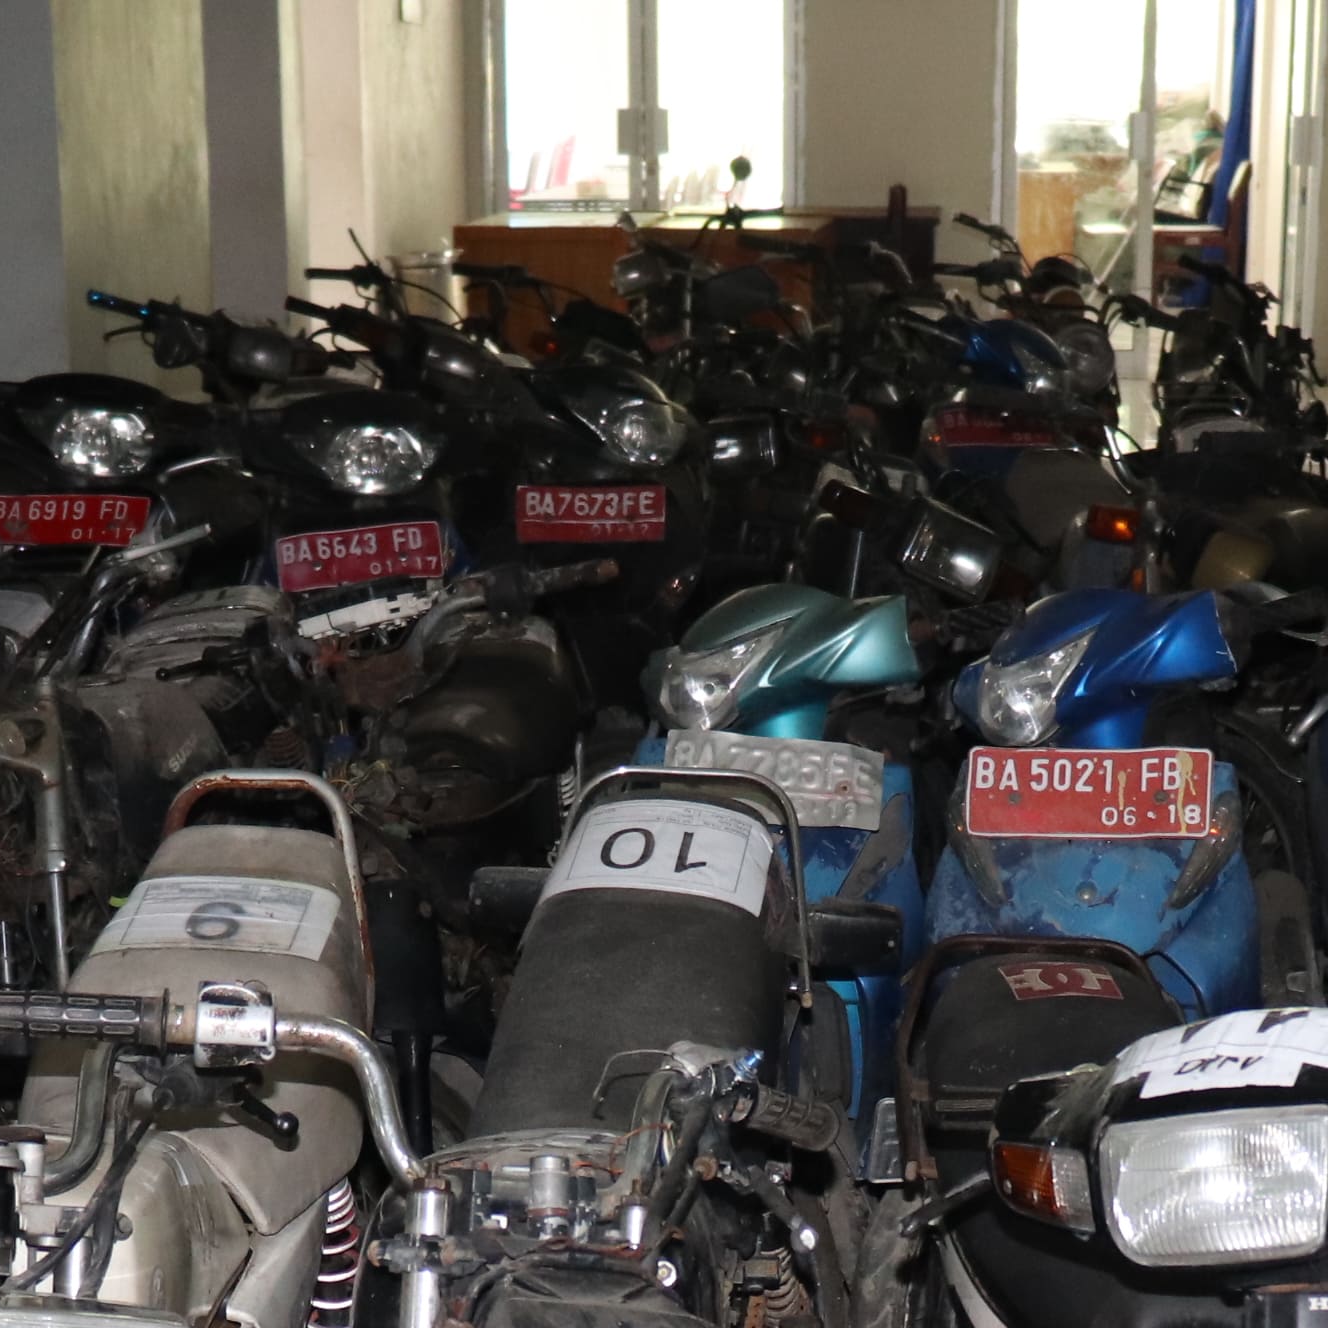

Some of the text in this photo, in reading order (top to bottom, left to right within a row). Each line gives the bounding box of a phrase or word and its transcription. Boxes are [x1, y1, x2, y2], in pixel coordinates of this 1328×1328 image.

[28, 500, 85, 521] 6919
[99, 500, 128, 520] FD
[526, 491, 655, 516] BA 7673 FE
[282, 527, 423, 565] BA 6643 FD
[975, 756, 1181, 793] BA 5021 FB
